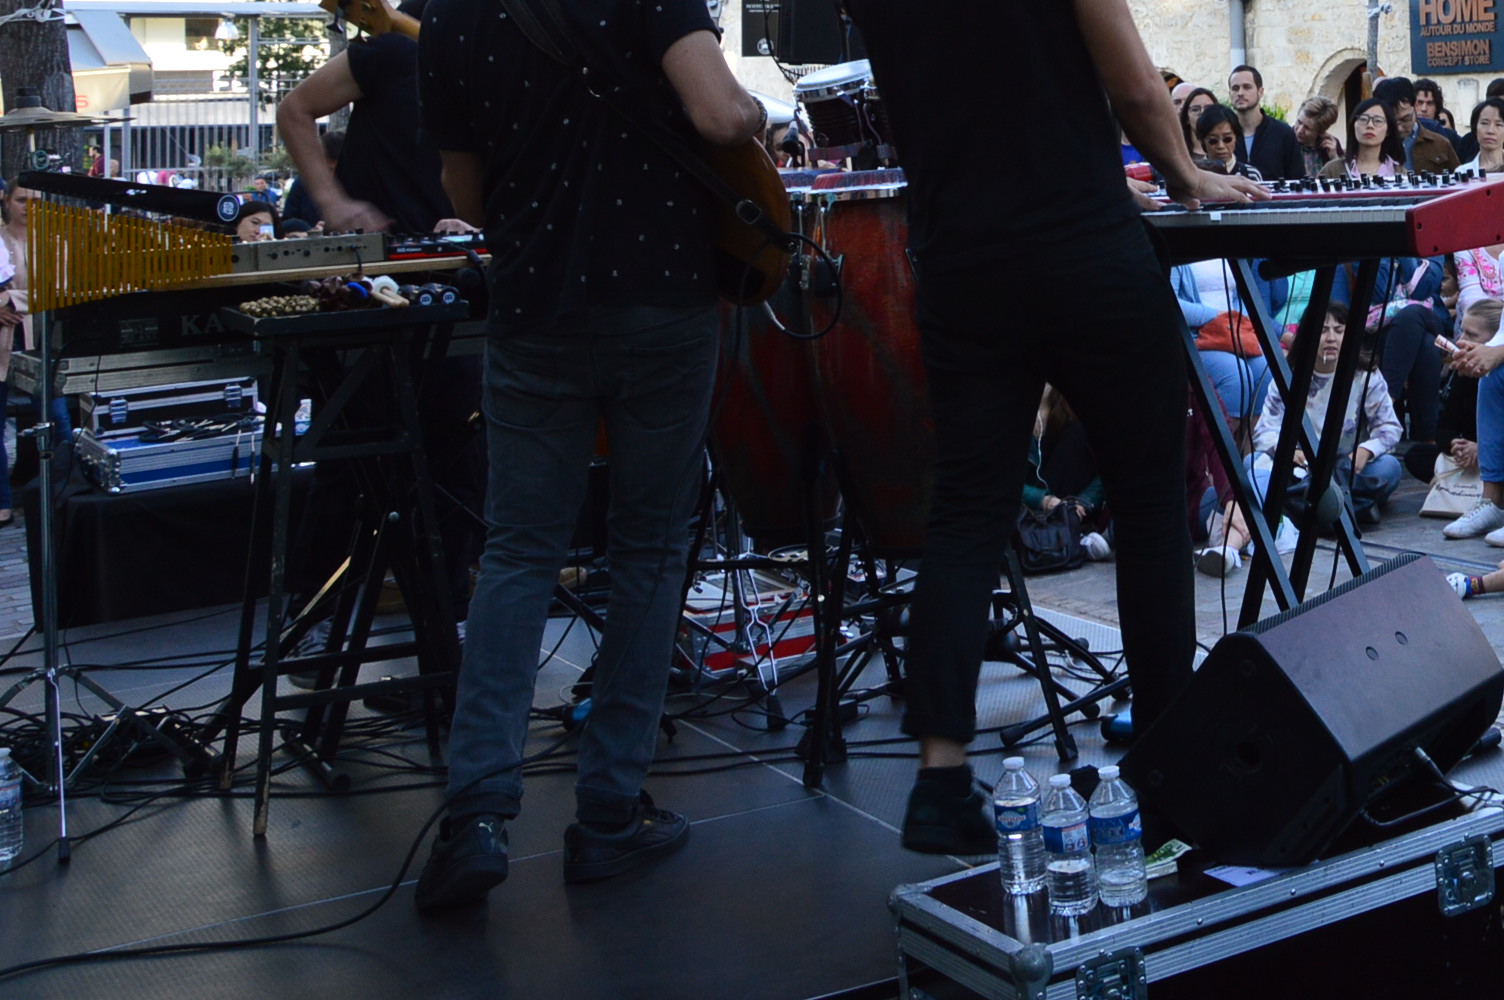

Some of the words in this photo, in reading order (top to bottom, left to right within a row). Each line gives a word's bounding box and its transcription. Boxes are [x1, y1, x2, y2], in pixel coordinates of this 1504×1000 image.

[1421, 24, 1452, 37] AUTOUR
[1453, 23, 1464, 34] DU
[1466, 21, 1495, 33] MONDE
[1426, 39, 1490, 57] BENSIMON
[1427, 56, 1462, 67] CONCEPT
[1464, 55, 1490, 65] STORE
[181, 312, 225, 336] KA
